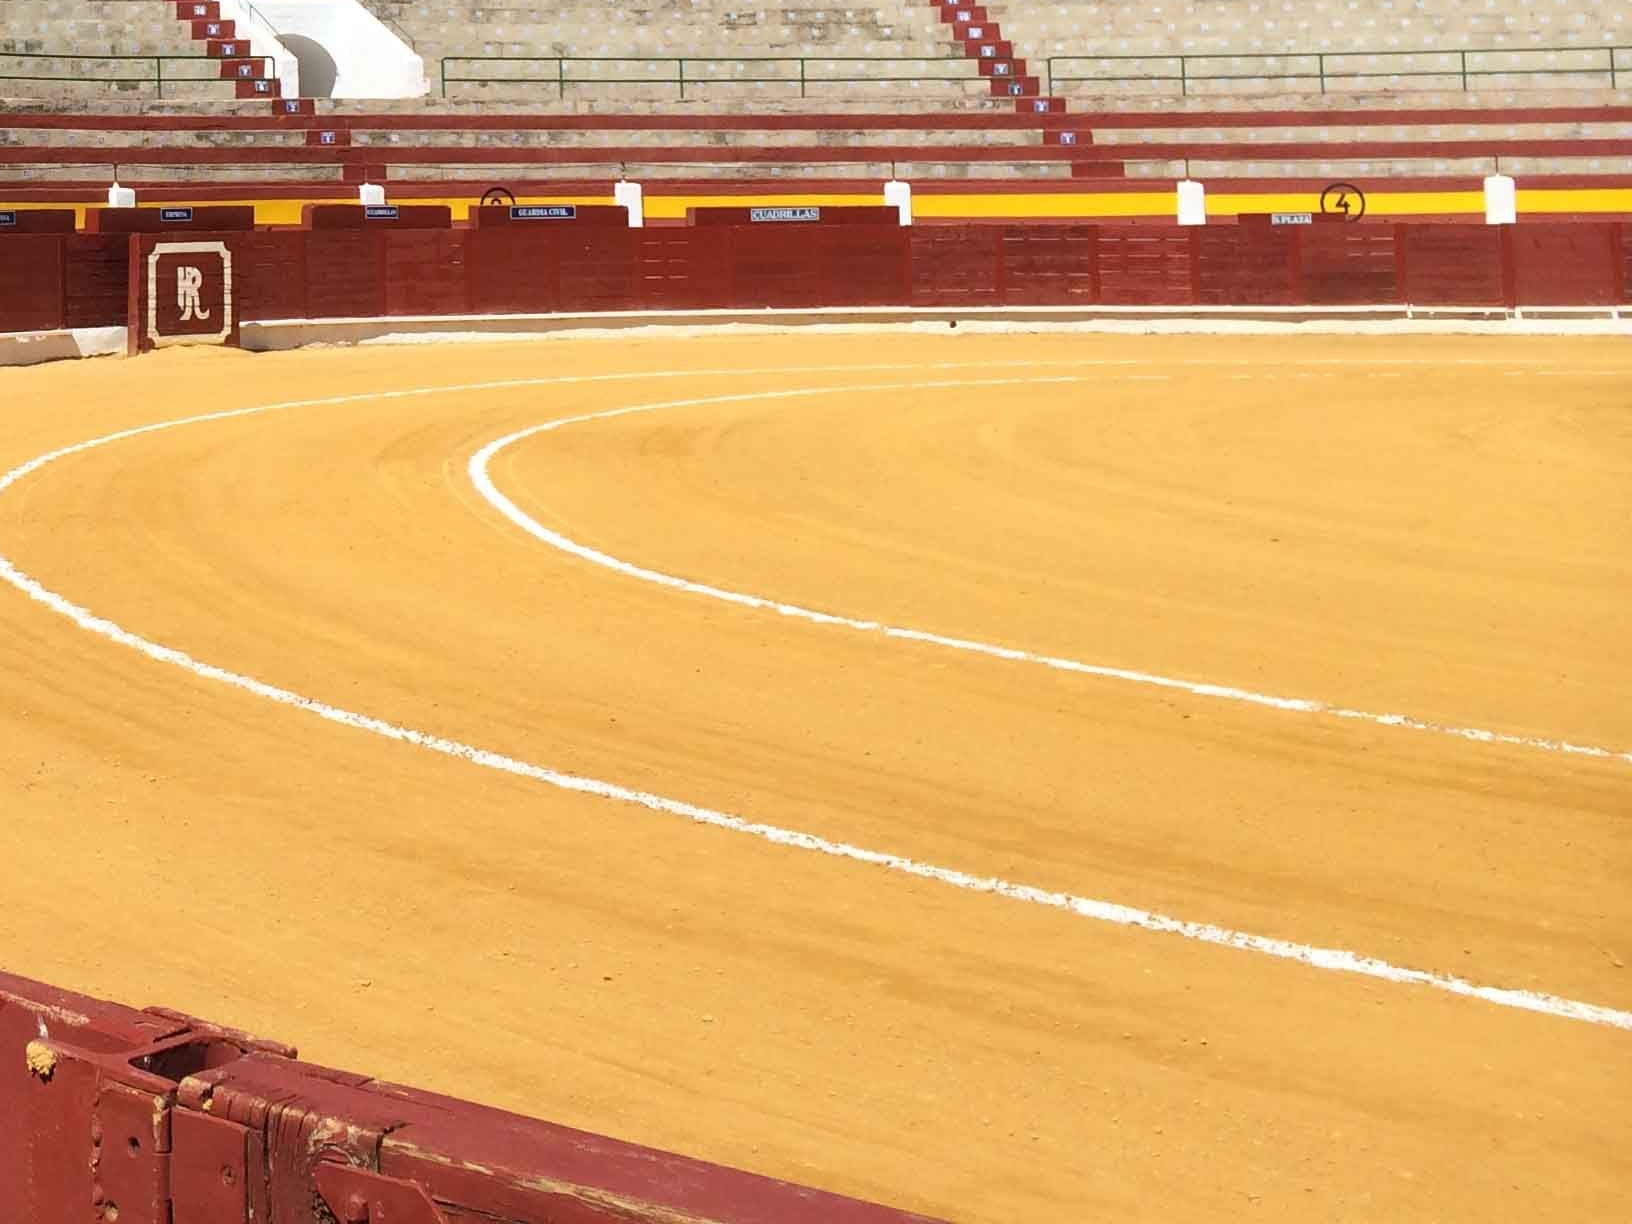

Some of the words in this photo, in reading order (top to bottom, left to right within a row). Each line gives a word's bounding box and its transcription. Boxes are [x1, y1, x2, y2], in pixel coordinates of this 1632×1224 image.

[1336, 192, 1351, 214] 4
[518, 208, 547, 217] GUARDIA
[548, 207, 568, 216] CIVIL
[753, 209, 817, 218] CUADRILLAS
